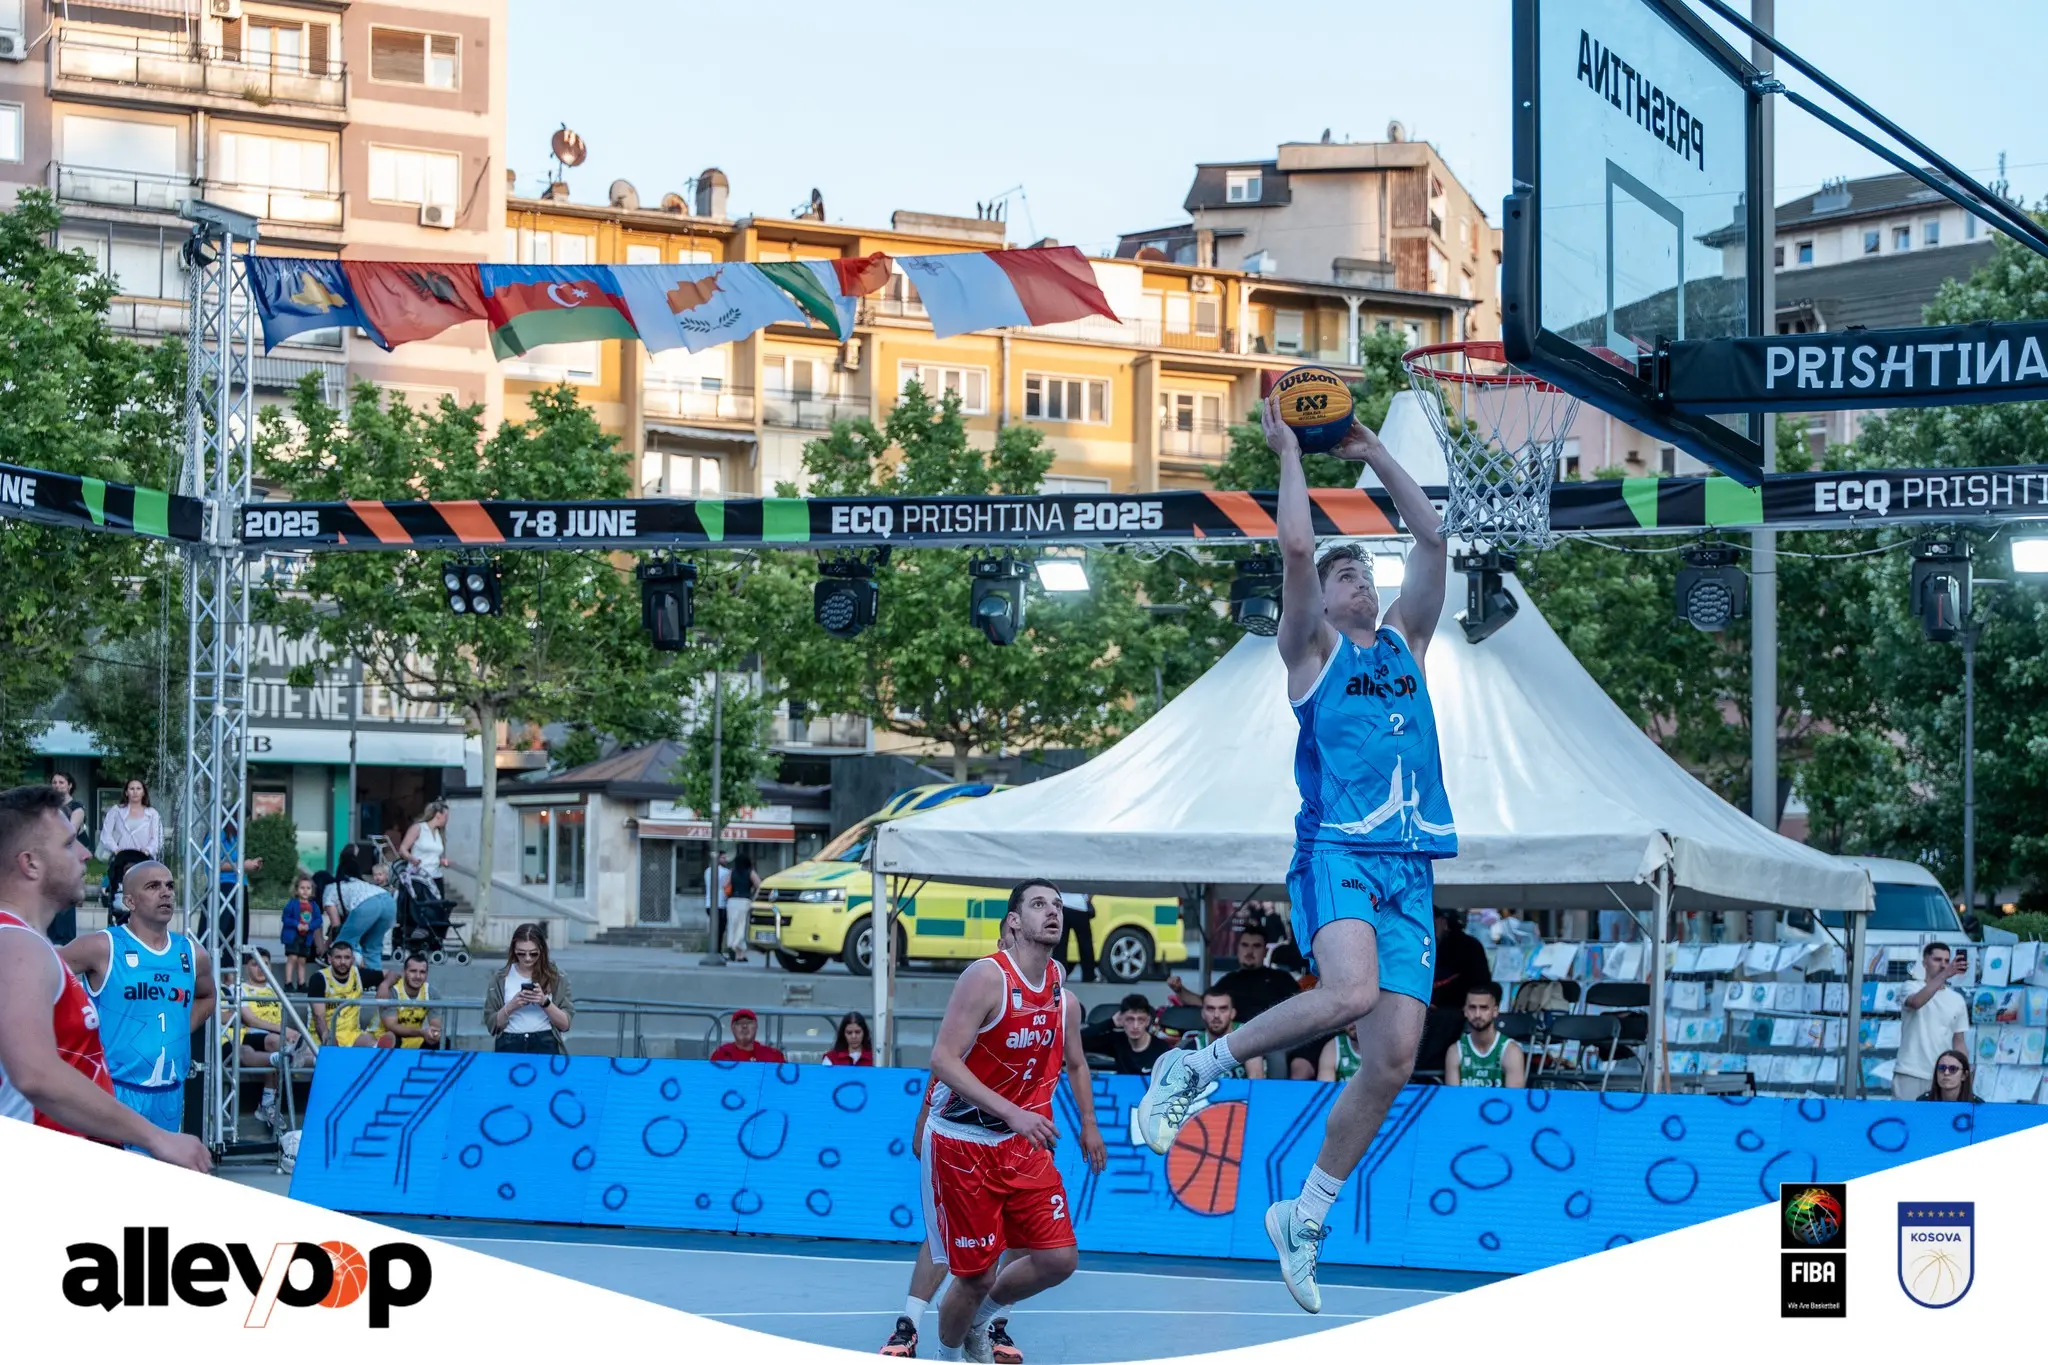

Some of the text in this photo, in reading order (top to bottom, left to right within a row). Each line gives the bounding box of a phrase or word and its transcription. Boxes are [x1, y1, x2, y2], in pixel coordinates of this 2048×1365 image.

[1280, 372, 1338, 391] Wilson
[1814, 479, 1891, 516] ECQ
[245, 510, 319, 538] 2025
[509, 509, 637, 537] 7-8 JUNE
[831, 501, 1164, 539] ECQ PRISHTINA 2025
[1389, 713, 1404, 736] 2
[157, 1012, 167, 1033] 1
[1022, 1057, 1038, 1081] 2
[1050, 1194, 1066, 1221] 2
